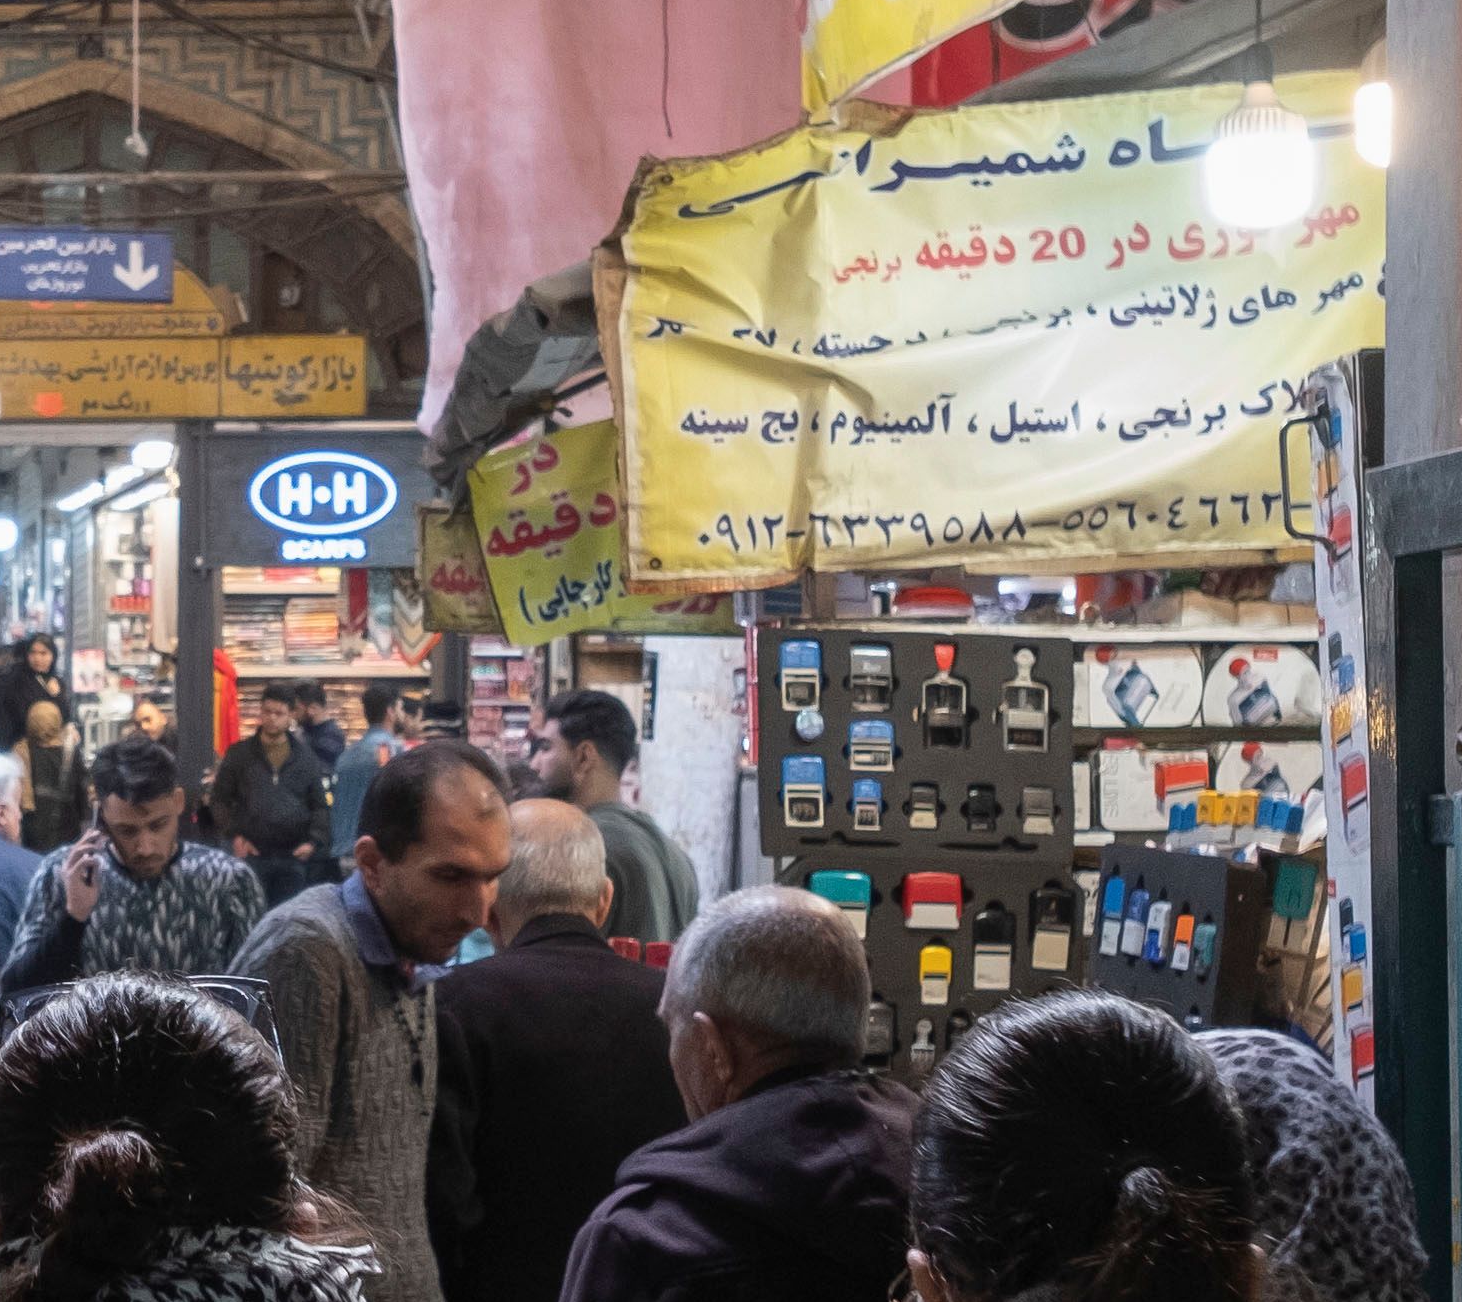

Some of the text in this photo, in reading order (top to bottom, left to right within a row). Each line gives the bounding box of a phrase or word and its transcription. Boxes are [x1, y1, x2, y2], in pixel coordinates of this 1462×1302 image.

[916, 226, 1016, 279] دقیقه
[1031, 227, 1086, 263] 20
[1105, 221, 1150, 270] در
[1169, 222, 1260, 261] وری
[834, 249, 903, 283] برنجی
[1110, 282, 1217, 329] ژلاتینی
[1229, 284, 1297, 327] های
[1312, 272, 1364, 314] مهر
[1240, 380, 1307, 415] لاک
[680, 409, 749, 444] سینه
[760, 409, 799, 443] بج
[990, 399, 1080, 443] استیل
[1119, 398, 1227, 441] برنجی
[510, 441, 558, 495] در
[487, 491, 616, 559] دقیقه
